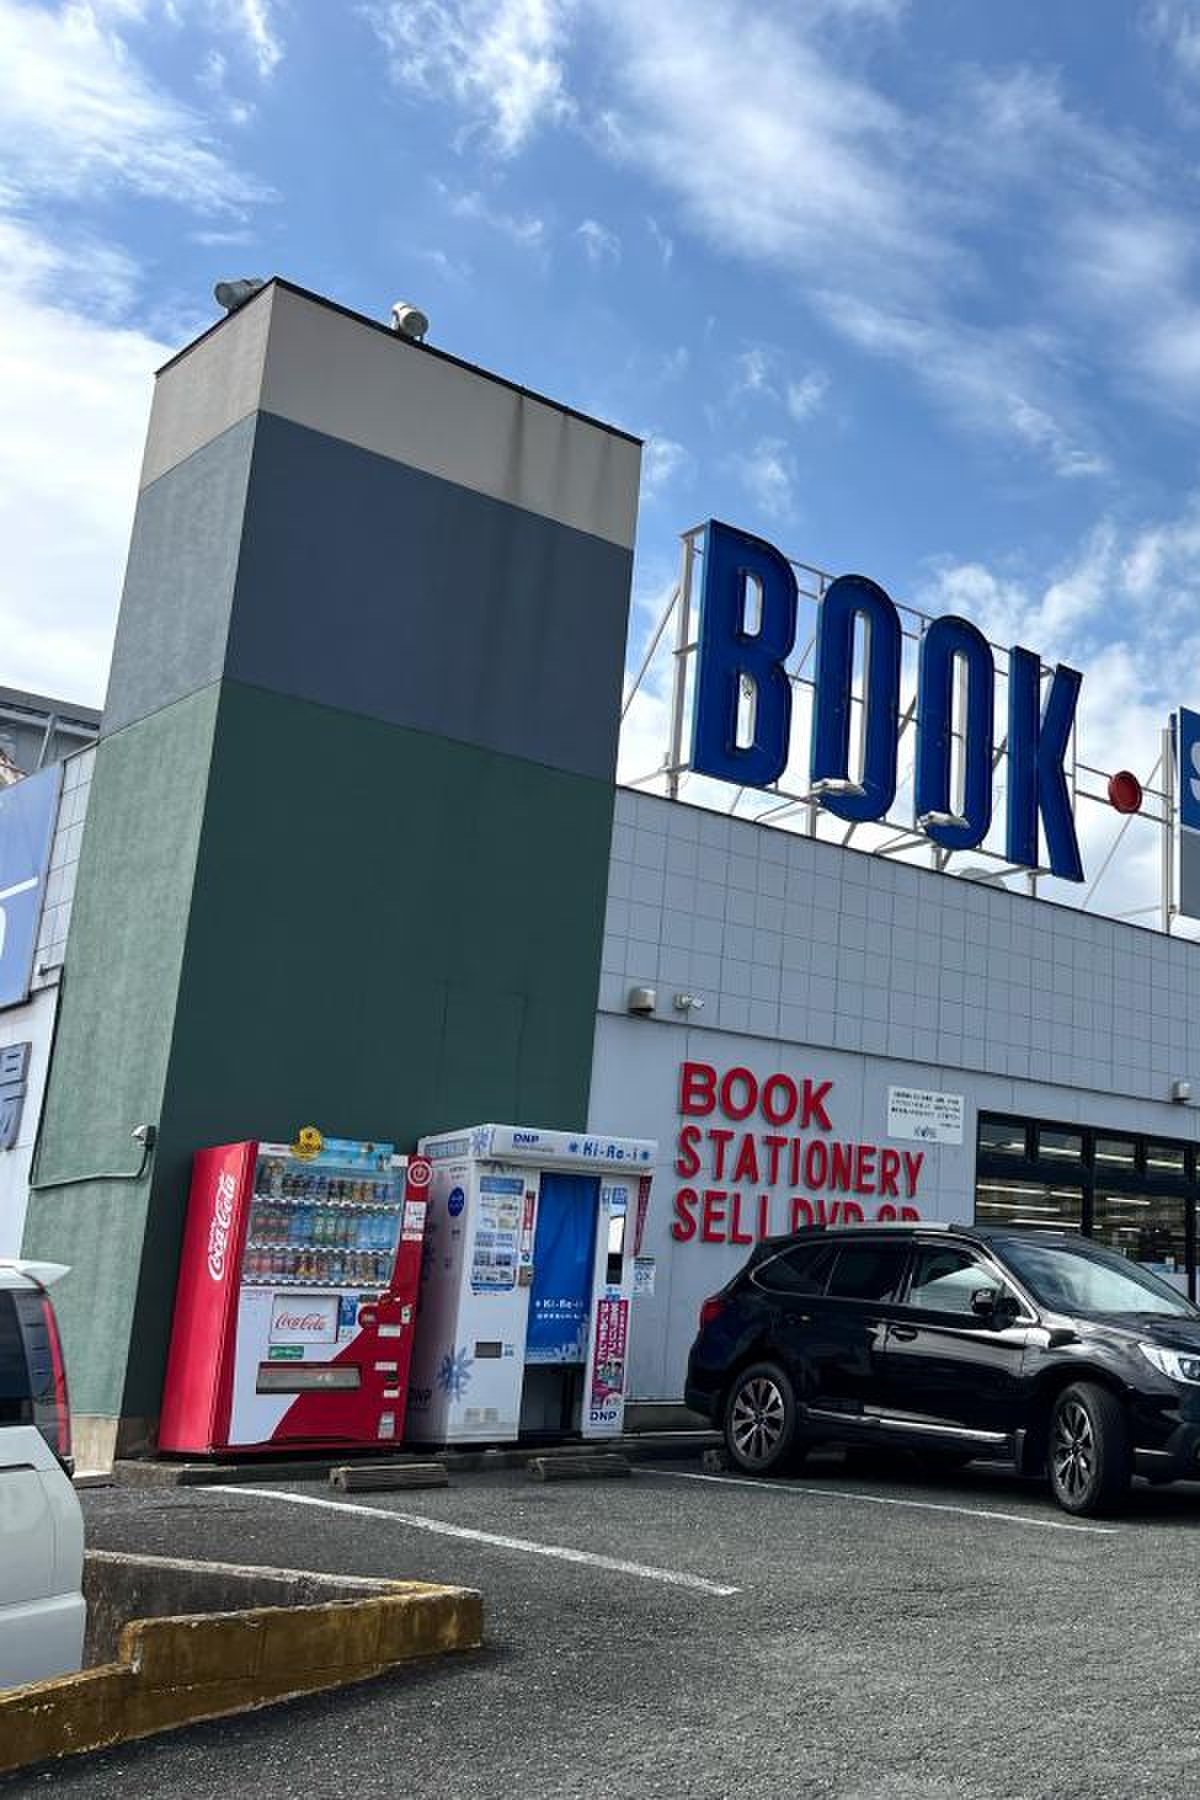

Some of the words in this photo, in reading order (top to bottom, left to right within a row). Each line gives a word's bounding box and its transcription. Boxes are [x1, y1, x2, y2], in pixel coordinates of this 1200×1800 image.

[690, 518, 1084, 882] BOOK
[679, 1061, 834, 1131] BOOK
[512, 1133, 540, 1144] DNP
[582, 1140, 638, 1160] Ki-Re-i
[676, 1125, 925, 1198] STATIONERY
[672, 1188, 769, 1245] SELL
[589, 1411, 617, 1421] DNP
